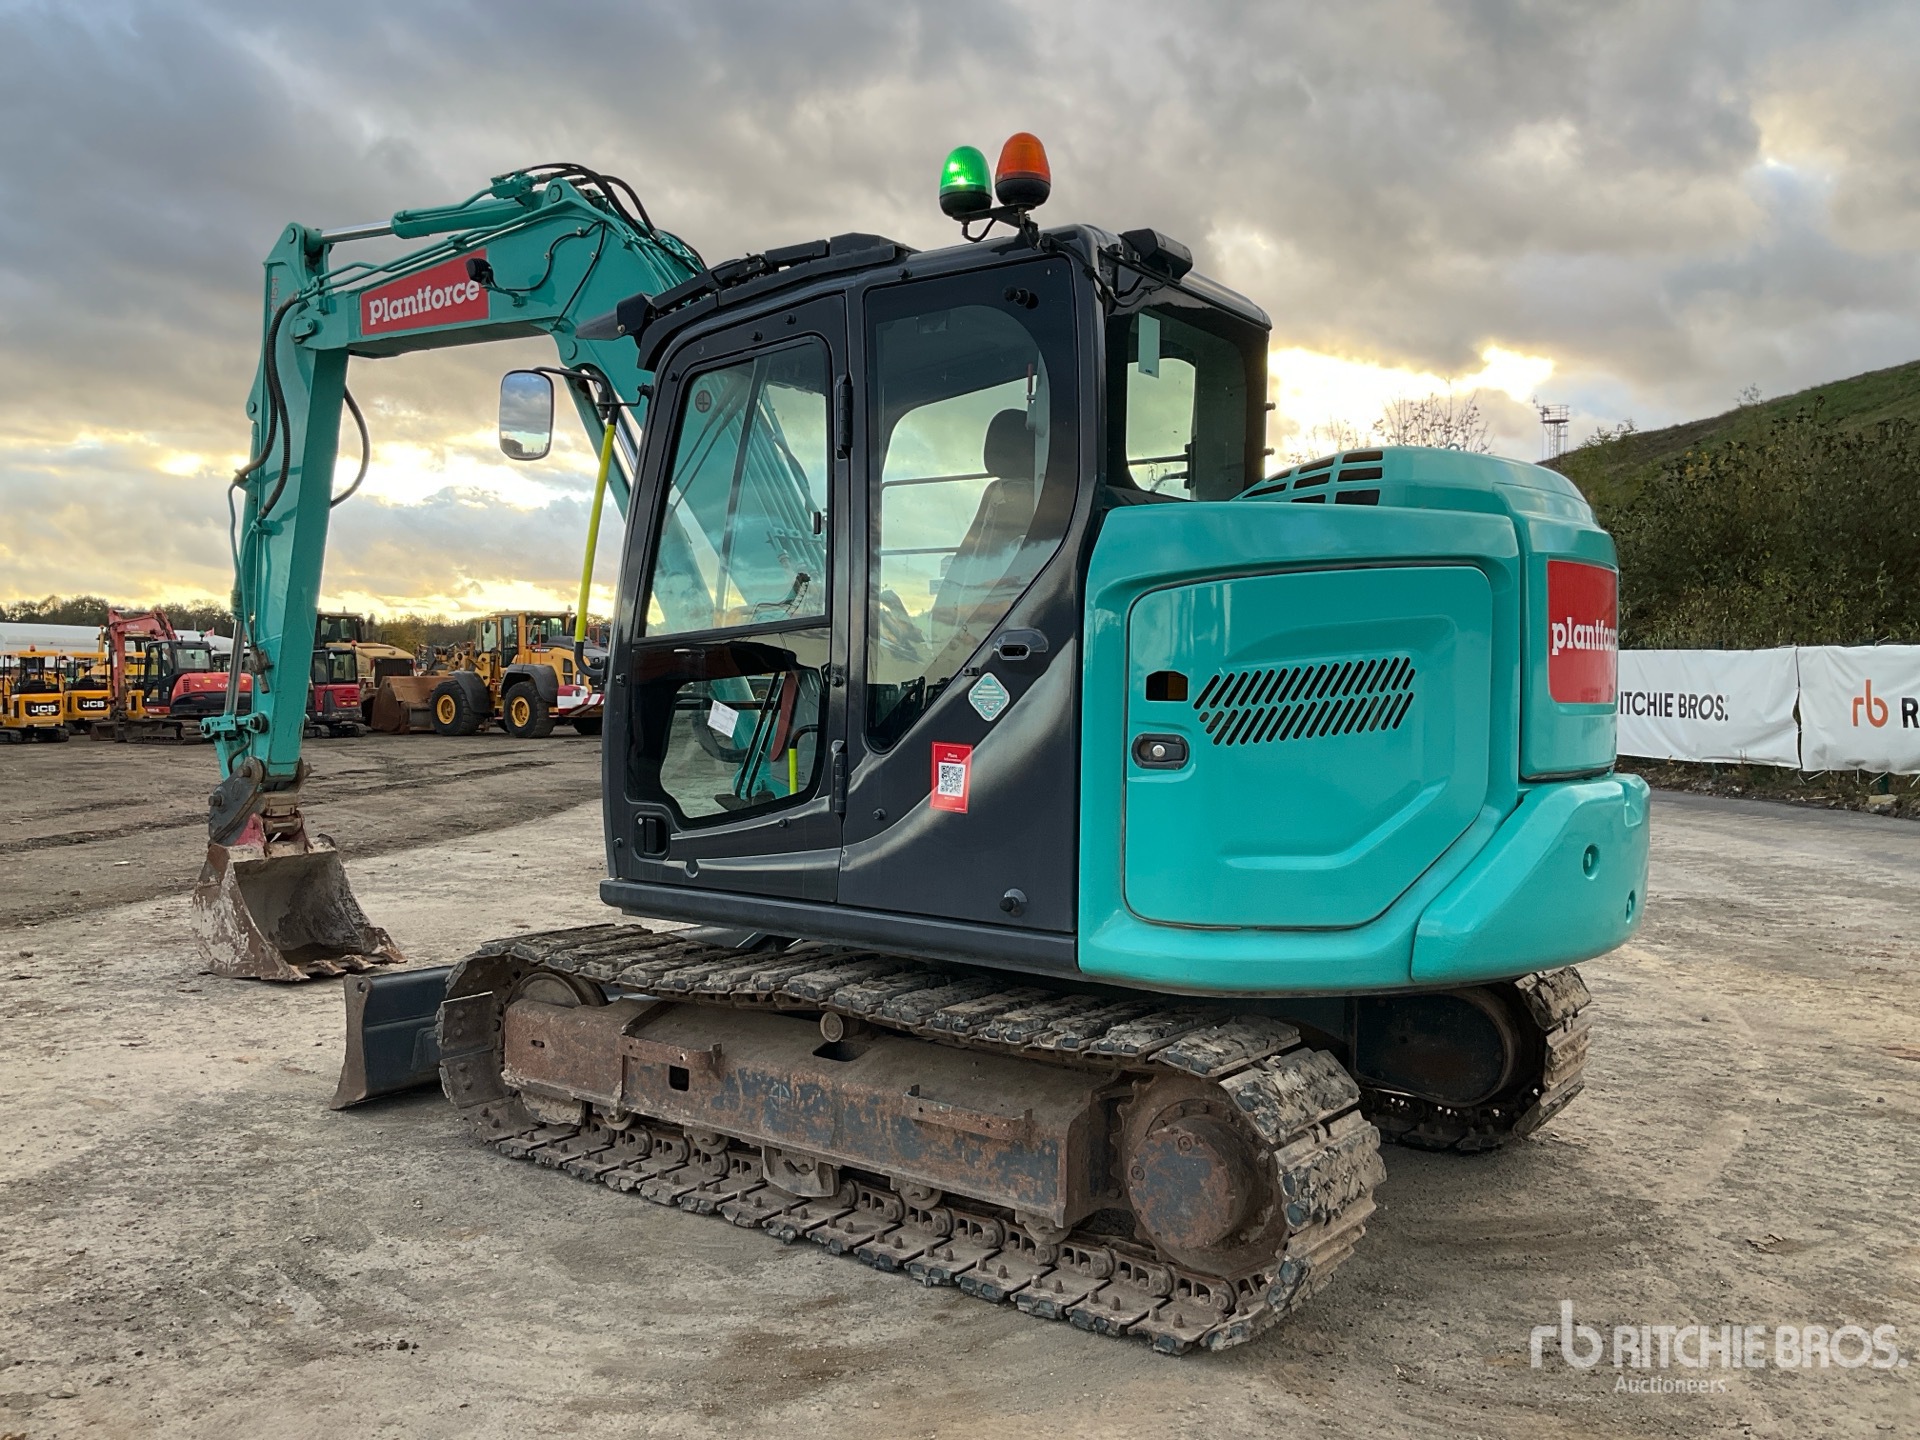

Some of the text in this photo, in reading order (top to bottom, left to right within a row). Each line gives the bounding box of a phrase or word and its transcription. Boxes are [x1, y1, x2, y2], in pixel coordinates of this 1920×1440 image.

[31, 704, 56, 713] JCB
[82, 700, 105, 708] JCB
[1618, 691, 1674, 718] ITCHIE
